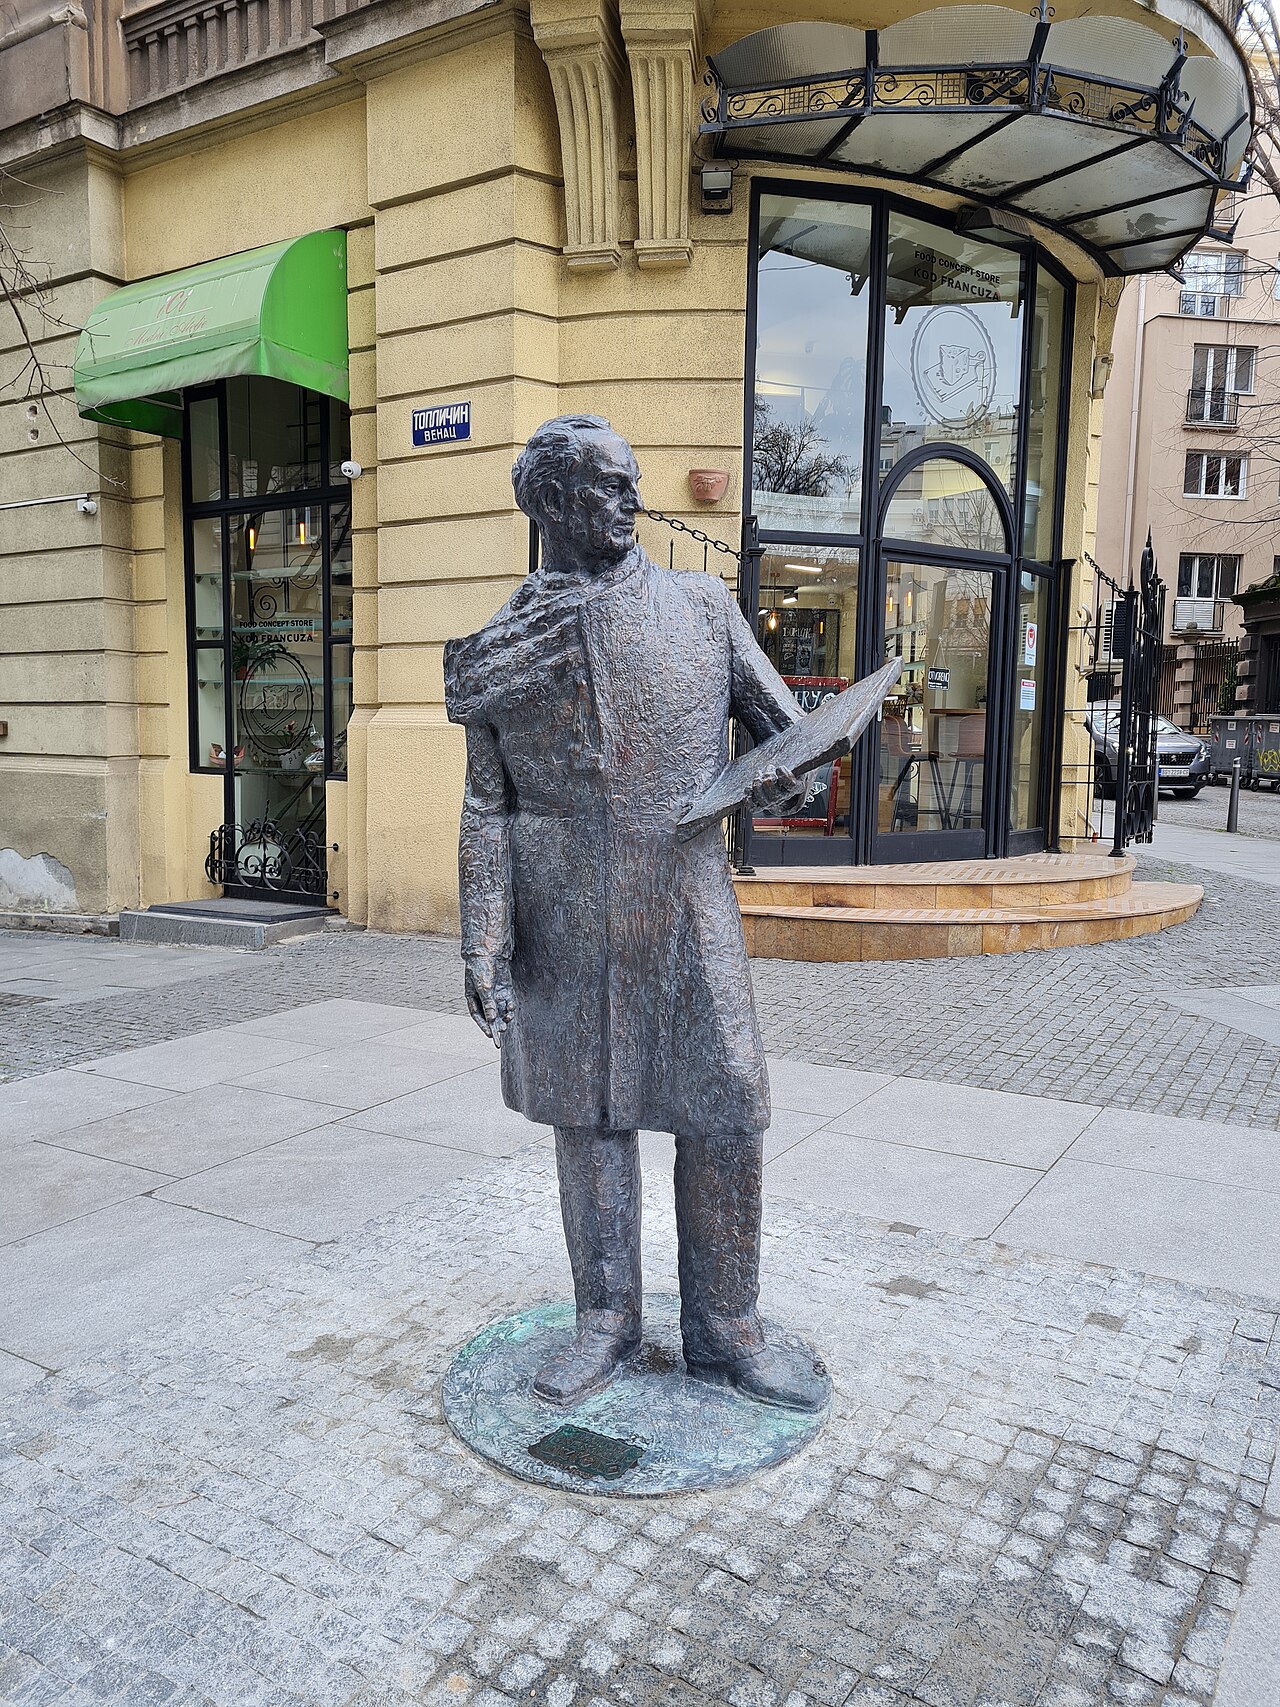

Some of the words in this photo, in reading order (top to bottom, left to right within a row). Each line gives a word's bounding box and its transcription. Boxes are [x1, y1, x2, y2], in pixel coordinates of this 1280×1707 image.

[915, 250, 937, 263] FOOD
[938, 258, 974, 276] CONCEPT
[975, 270, 1001, 284] STORE
[913, 267, 937, 283] KOD
[940, 275, 999, 301] FRANCUZA
[413, 404, 469, 431] ТОПЛИЧИН
[424, 426, 457, 442] ВЕНАЦ
[258, 620, 289, 628] CONCEPT
[290, 619, 313, 627] STORE
[240, 634, 259, 644] KOD
[261, 633, 314, 643] FRANCUZA
